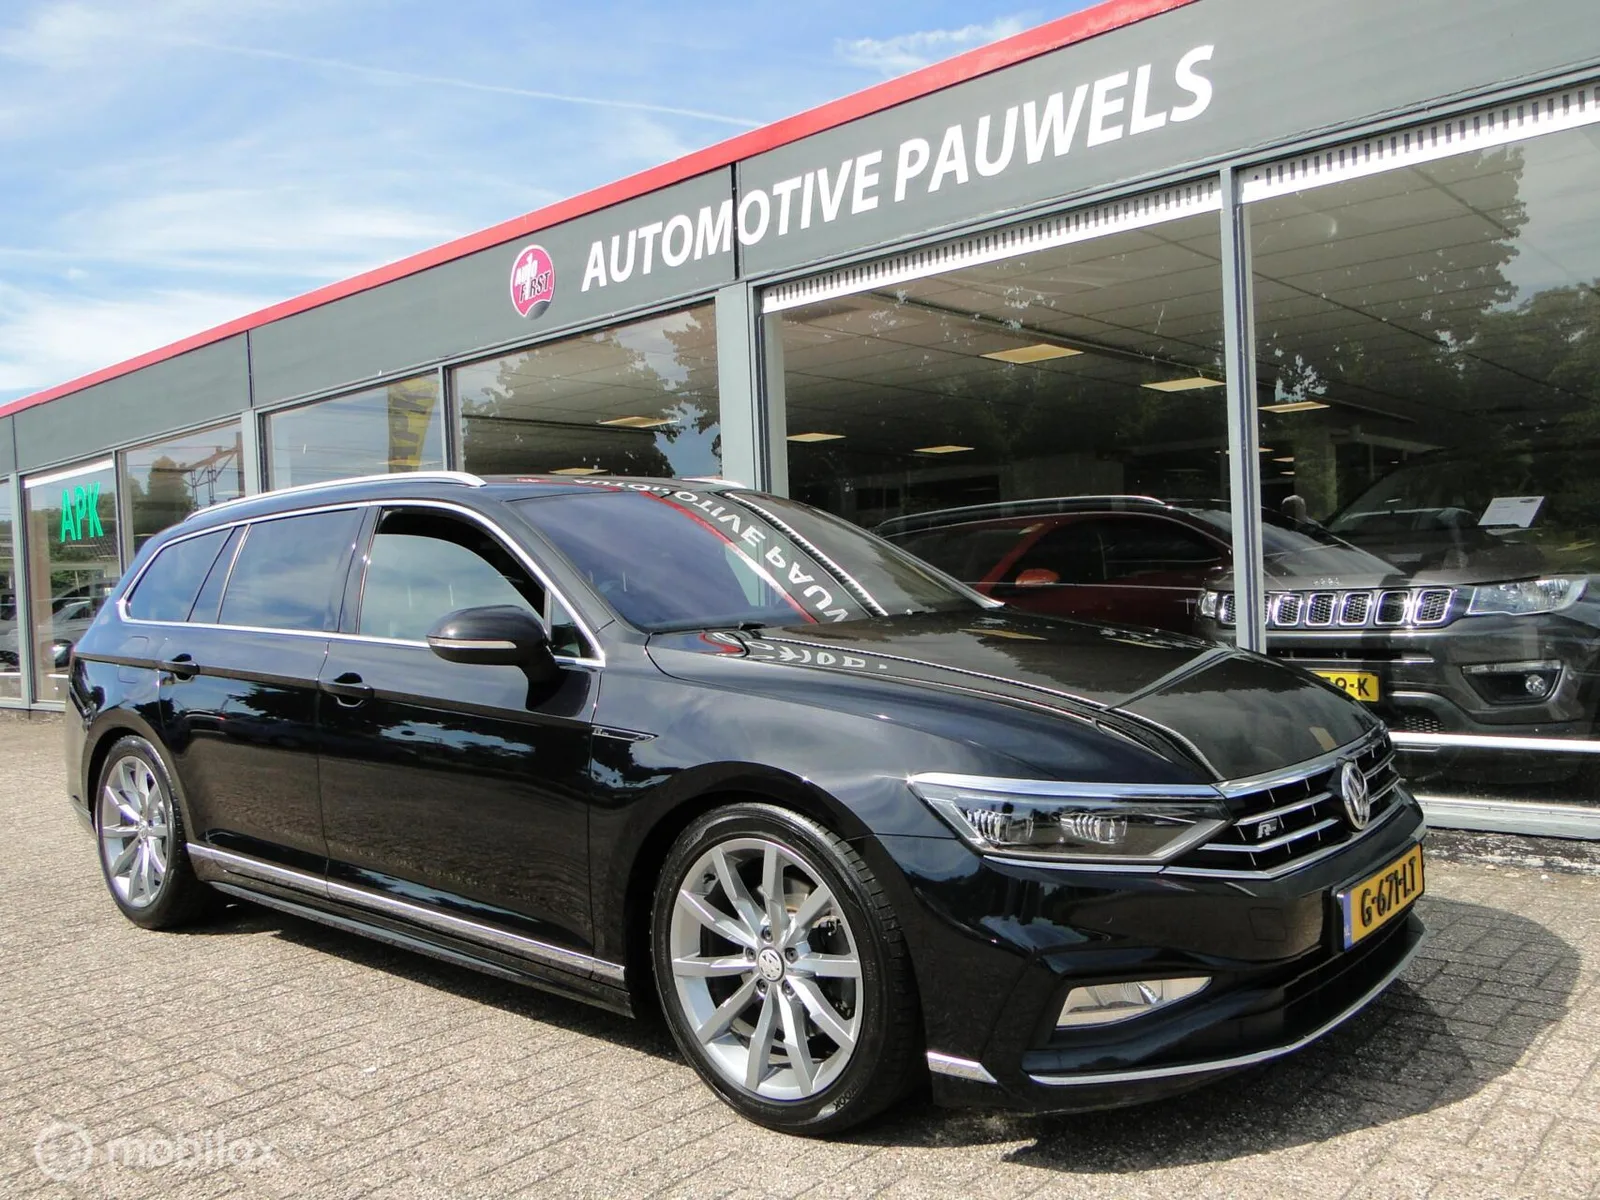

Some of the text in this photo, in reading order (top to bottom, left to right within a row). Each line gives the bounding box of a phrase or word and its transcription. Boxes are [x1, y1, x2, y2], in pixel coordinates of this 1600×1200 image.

[581, 44, 1214, 292] AUTOMOTIVE PAUWELS
[60, 481, 104, 543] APK
